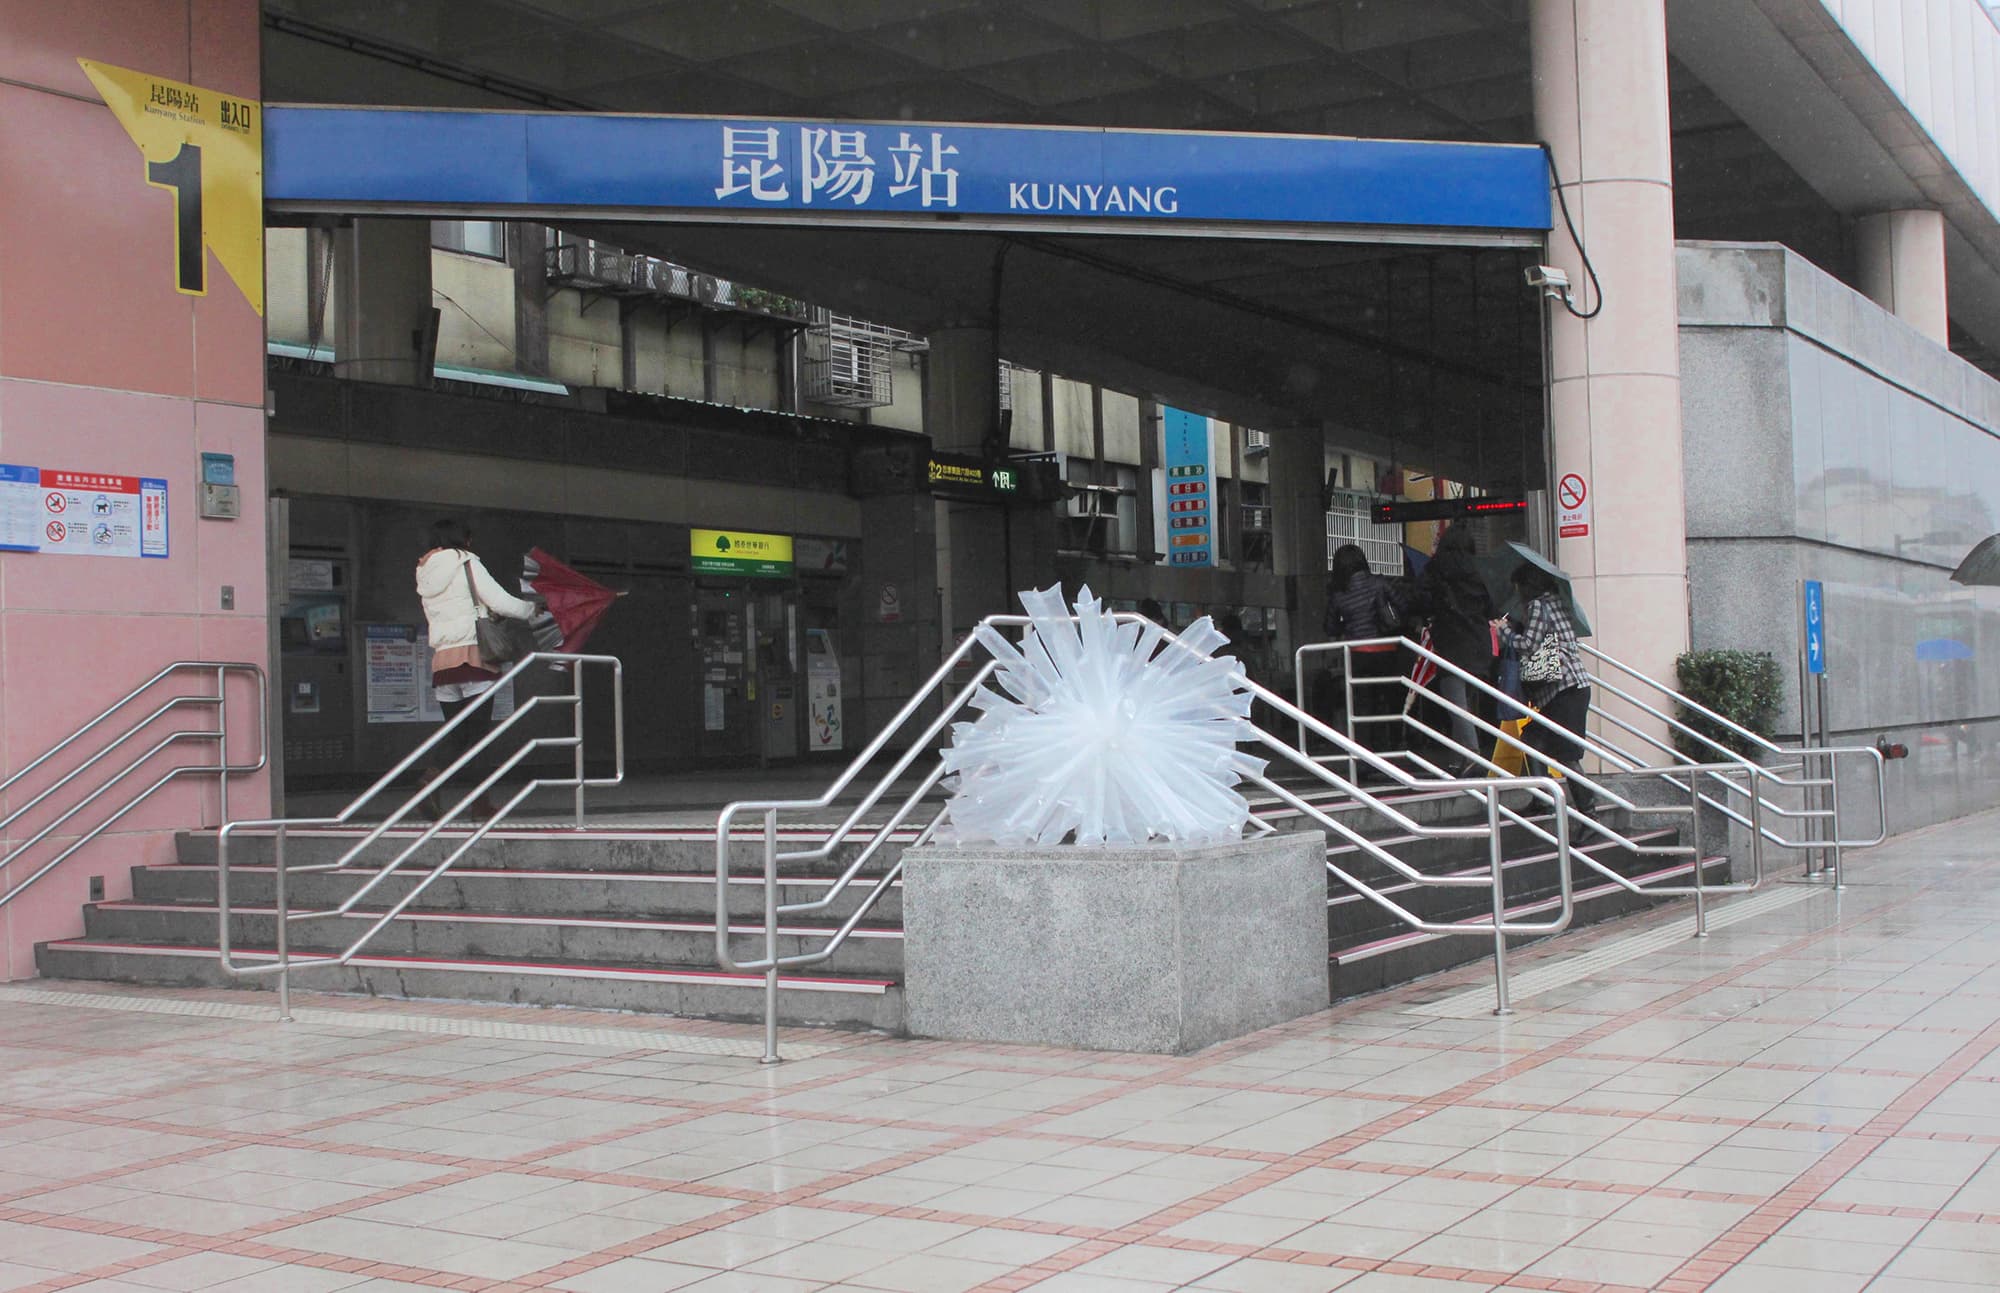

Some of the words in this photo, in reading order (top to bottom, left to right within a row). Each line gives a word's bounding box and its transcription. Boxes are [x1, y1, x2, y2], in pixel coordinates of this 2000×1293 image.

[150, 83, 199, 113] 昆陽站
[144, 103, 177, 121] Kunyang
[179, 111, 206, 126] Station
[221, 100, 250, 128] 出入口
[714, 125, 960, 208] 昆陽站
[1009, 182, 1178, 214] KUNYANG
[149, 143, 203, 292] 1
[935, 464, 943, 479] 2
